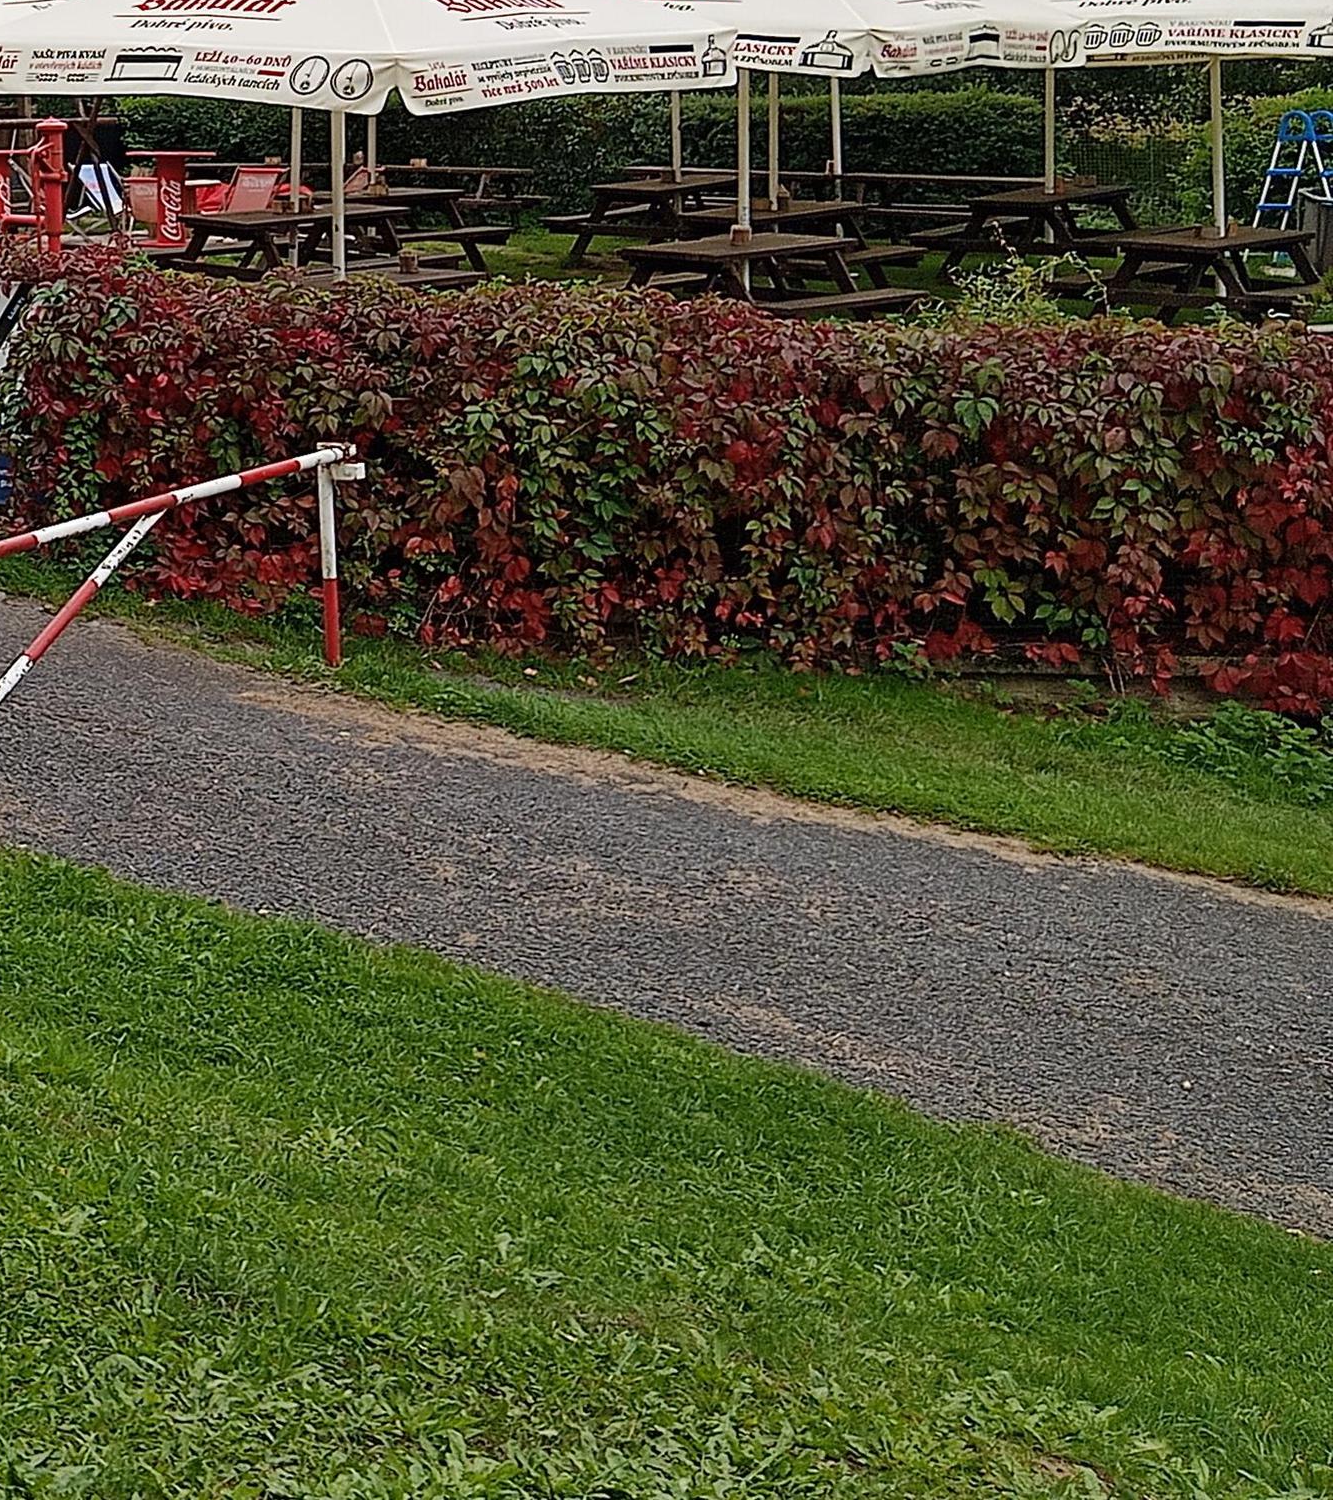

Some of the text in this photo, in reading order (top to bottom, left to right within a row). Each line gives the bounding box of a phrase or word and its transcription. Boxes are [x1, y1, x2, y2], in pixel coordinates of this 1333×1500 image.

[130, 18, 234, 31] Dobré pivo.
[1229, 28, 1303, 39] KLASICKY
[734, 42, 797, 56] LASICKY
[649, 55, 697, 69] KLASICKY
[413, 69, 468, 93] Bakalář
